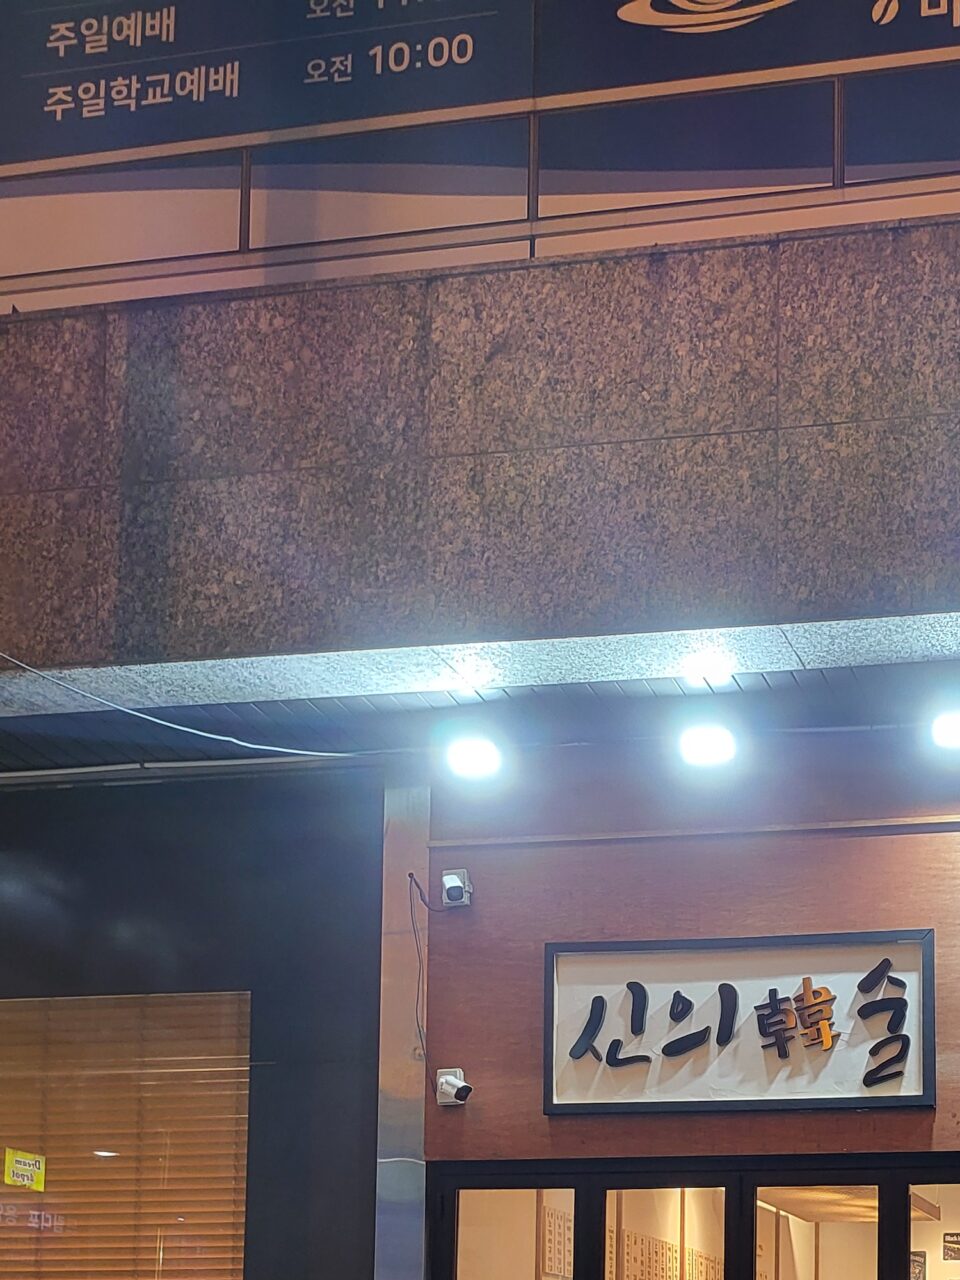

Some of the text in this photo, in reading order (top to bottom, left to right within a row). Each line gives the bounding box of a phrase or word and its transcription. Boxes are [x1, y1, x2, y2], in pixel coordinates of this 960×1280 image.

[46, 6, 176, 57] 주일예배
[43, 33, 474, 121] 주일학교예배 오전 10:00
